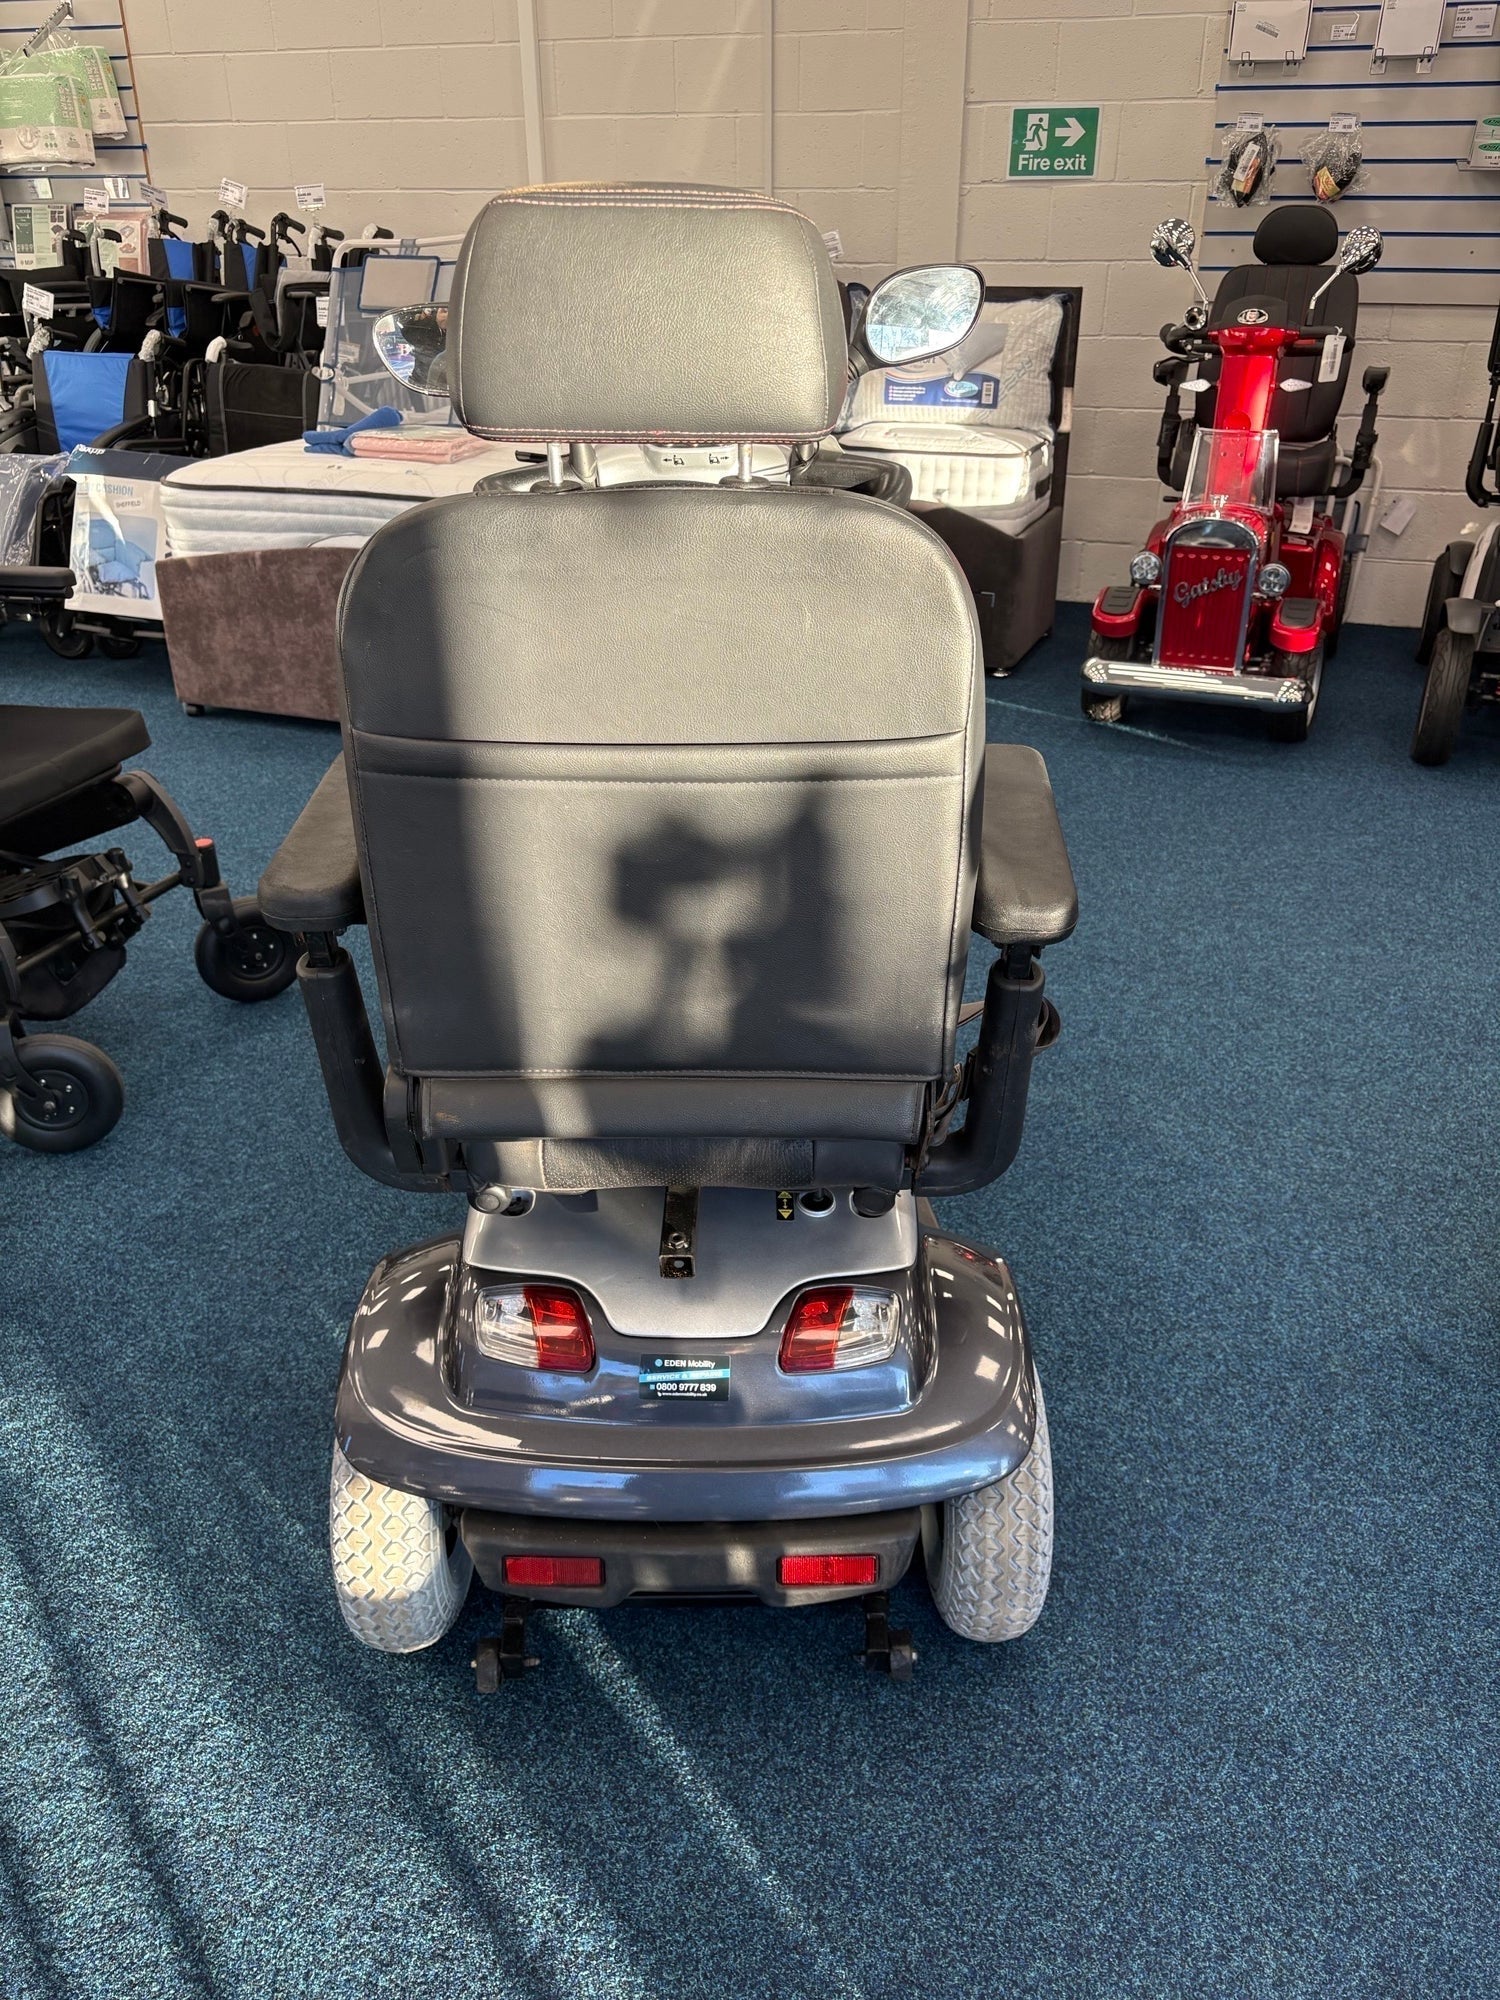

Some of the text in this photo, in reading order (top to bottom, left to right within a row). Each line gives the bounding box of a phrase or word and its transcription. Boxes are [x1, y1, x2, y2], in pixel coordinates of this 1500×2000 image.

[1018, 154, 1087, 171] Fire exit
[1174, 568, 1243, 608] Gatsby
[688, 1360, 716, 1369] Mobility
[656, 1382, 717, 1392] 0800 9777 839
